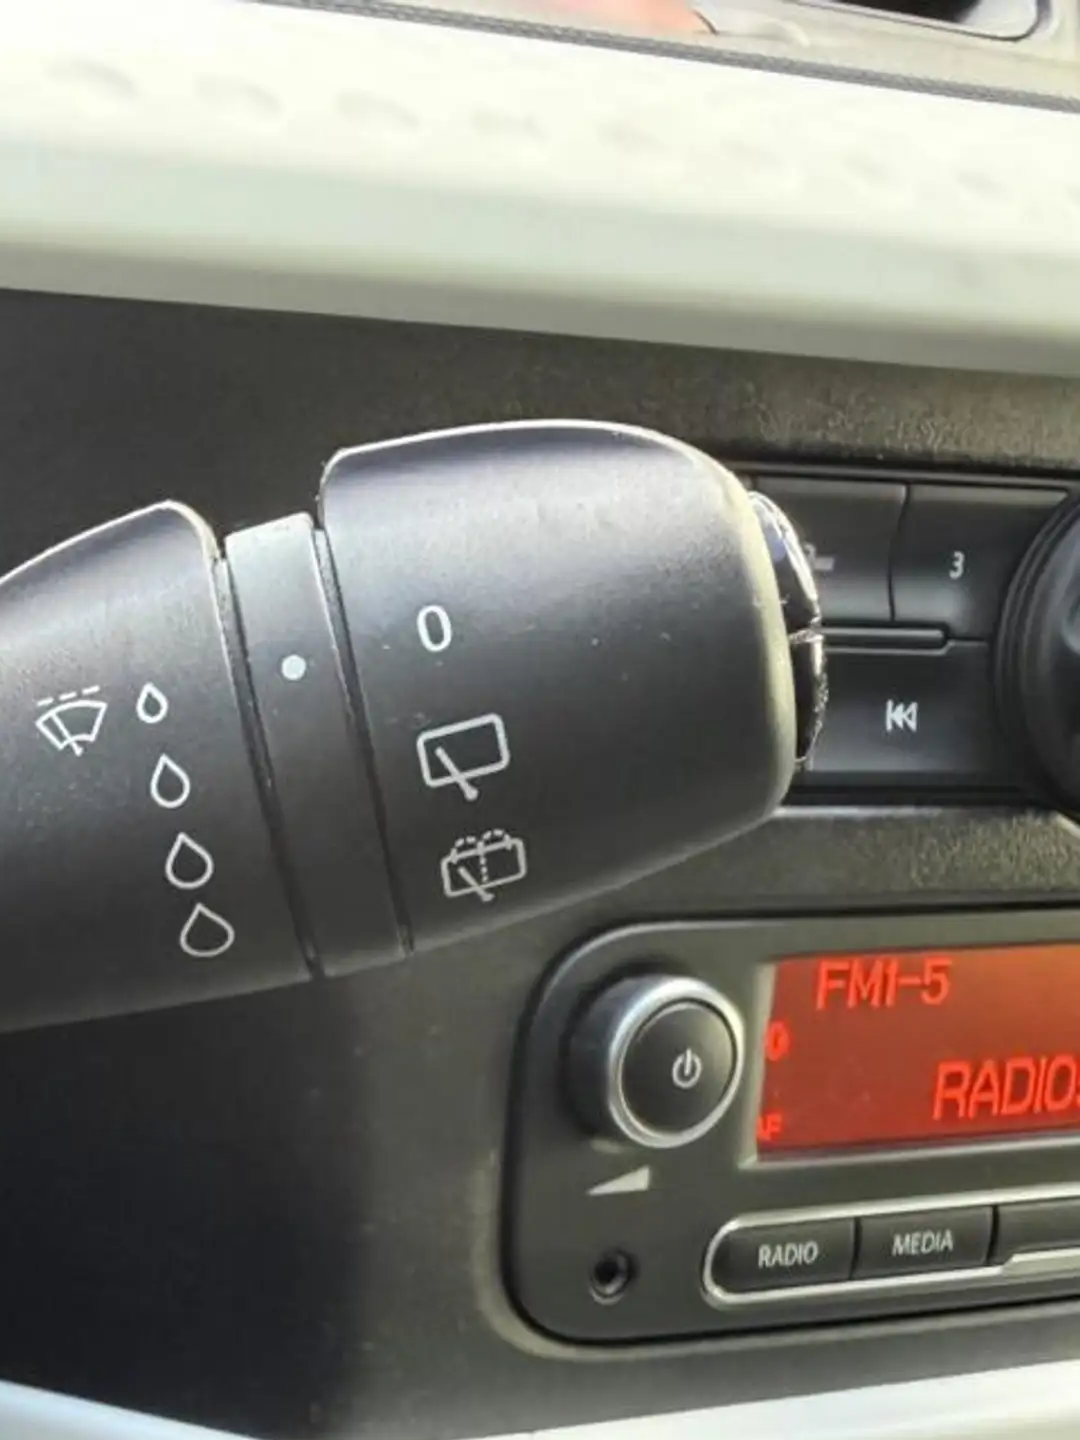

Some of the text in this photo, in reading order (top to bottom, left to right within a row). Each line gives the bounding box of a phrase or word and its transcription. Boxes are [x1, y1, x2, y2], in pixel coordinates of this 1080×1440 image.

[949, 552, 964, 579] 3
[417, 604, 452, 652] 0
[932, 1055, 1080, 1120] RADIO
[758, 1243, 818, 1269] RADIO
[891, 1229, 954, 1256] MEDIA
